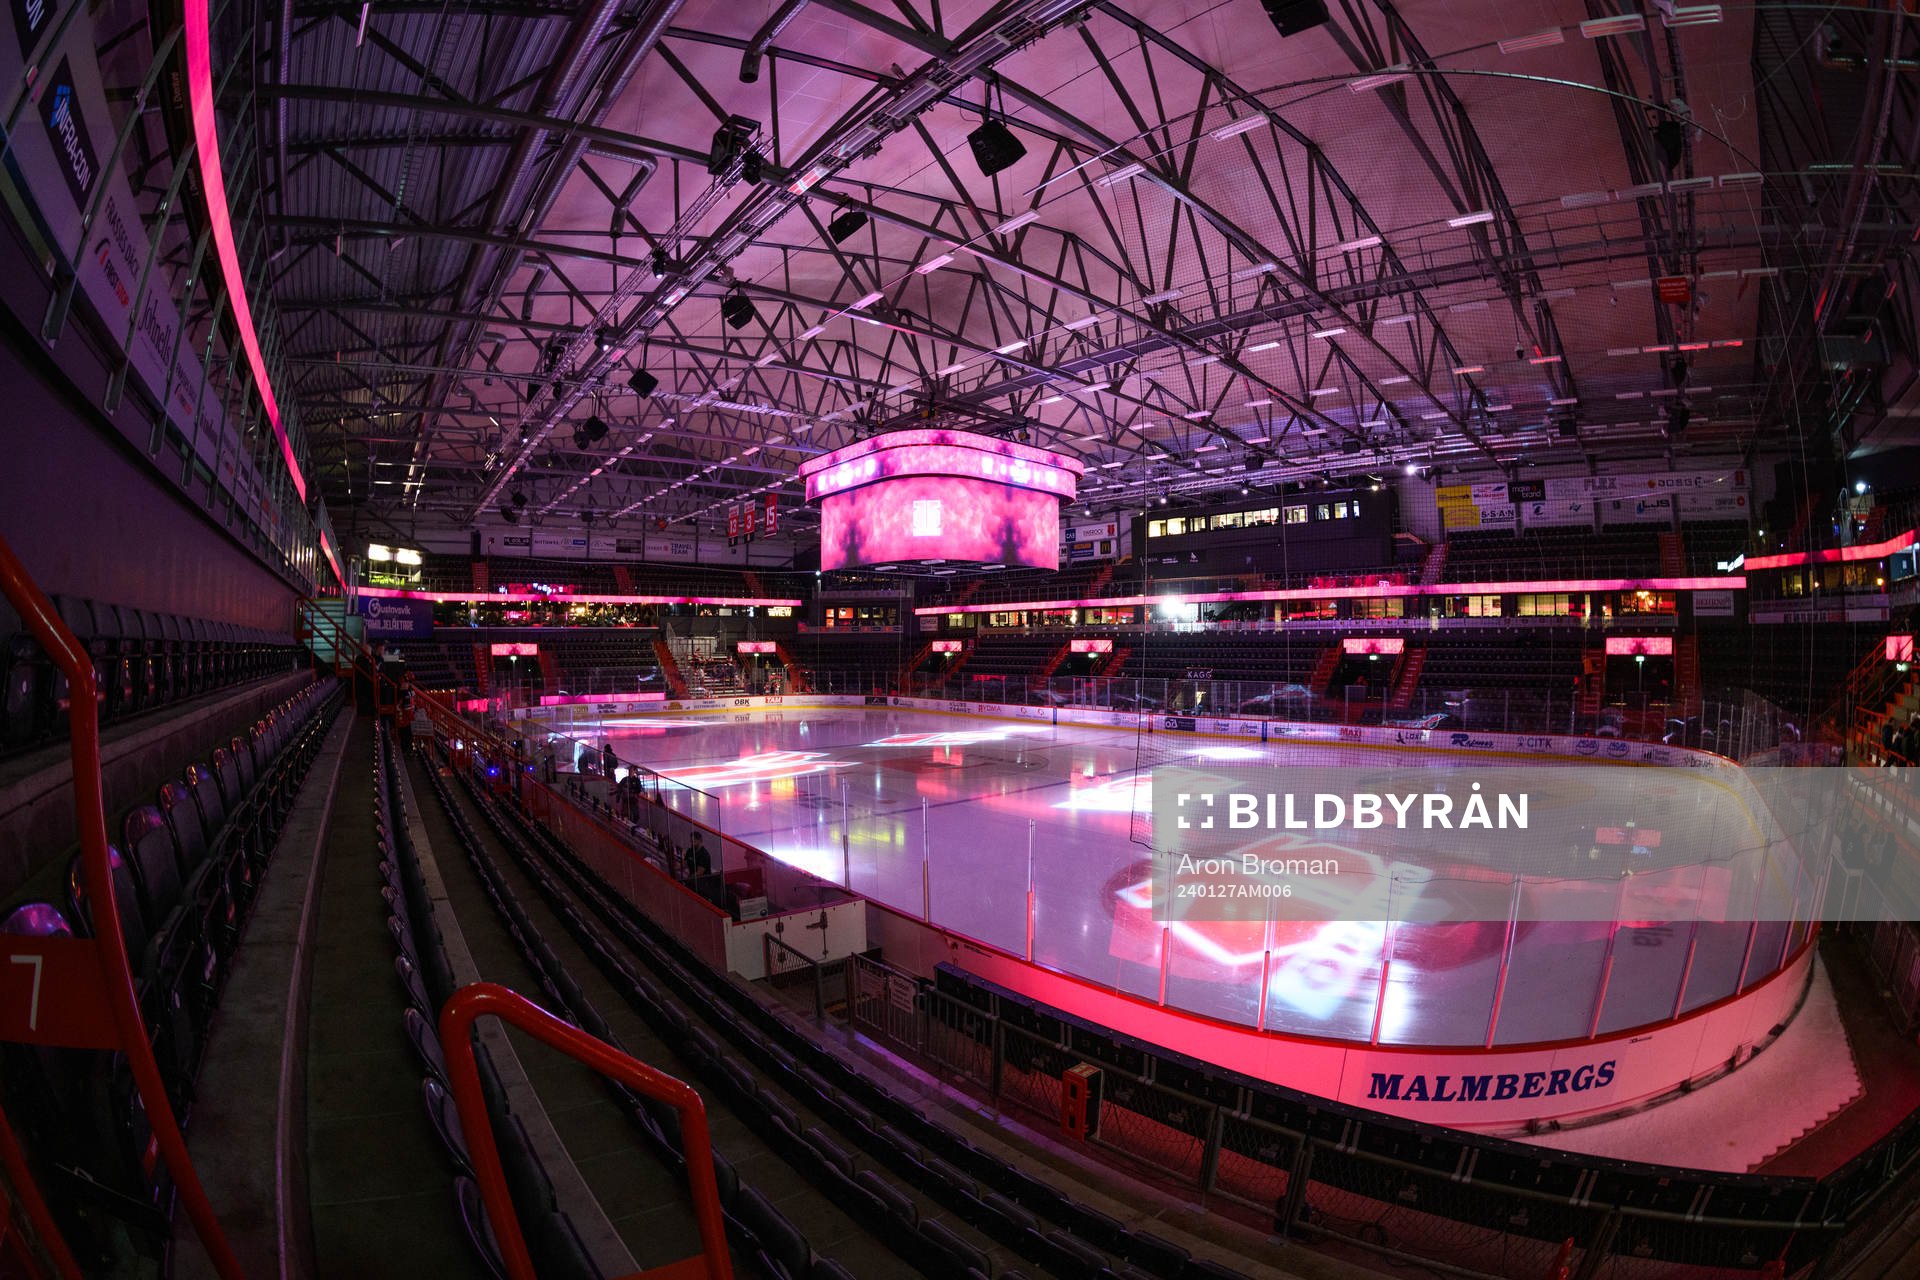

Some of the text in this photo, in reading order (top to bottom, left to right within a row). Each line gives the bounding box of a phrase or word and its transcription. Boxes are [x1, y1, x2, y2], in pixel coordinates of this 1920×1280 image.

[55, 96, 92, 192] INFRA-CON
[1522, 489, 1541, 498] brand
[766, 505, 776, 526] 15
[10, 954, 43, 1032] 7
[1367, 1060, 1616, 1102] MALMBERGS
